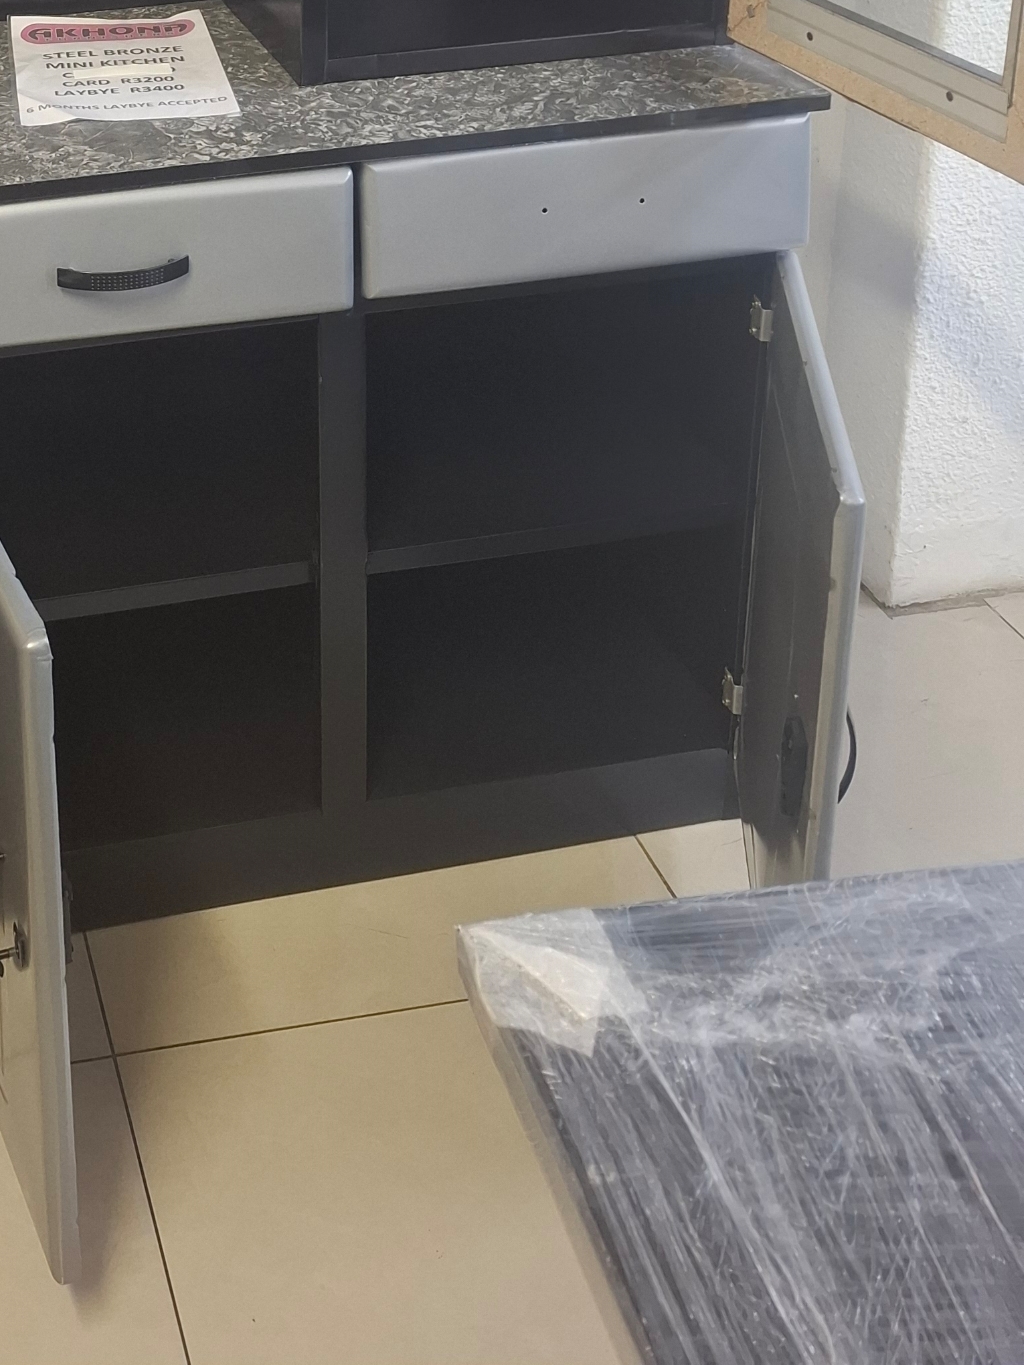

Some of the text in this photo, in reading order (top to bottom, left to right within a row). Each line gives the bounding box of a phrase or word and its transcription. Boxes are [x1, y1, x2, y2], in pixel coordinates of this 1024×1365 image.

[28, 23, 188, 41] AKHONA
[42, 45, 184, 60] STEEL BRONZE
[45, 55, 185, 70] MINI KITCHEN
[62, 75, 174, 88] CARD R3200
[54, 83, 185, 97] LAYBYE R3400
[26, 96, 228, 114] 6 MONTHS LAYBYE ACCEPTED
